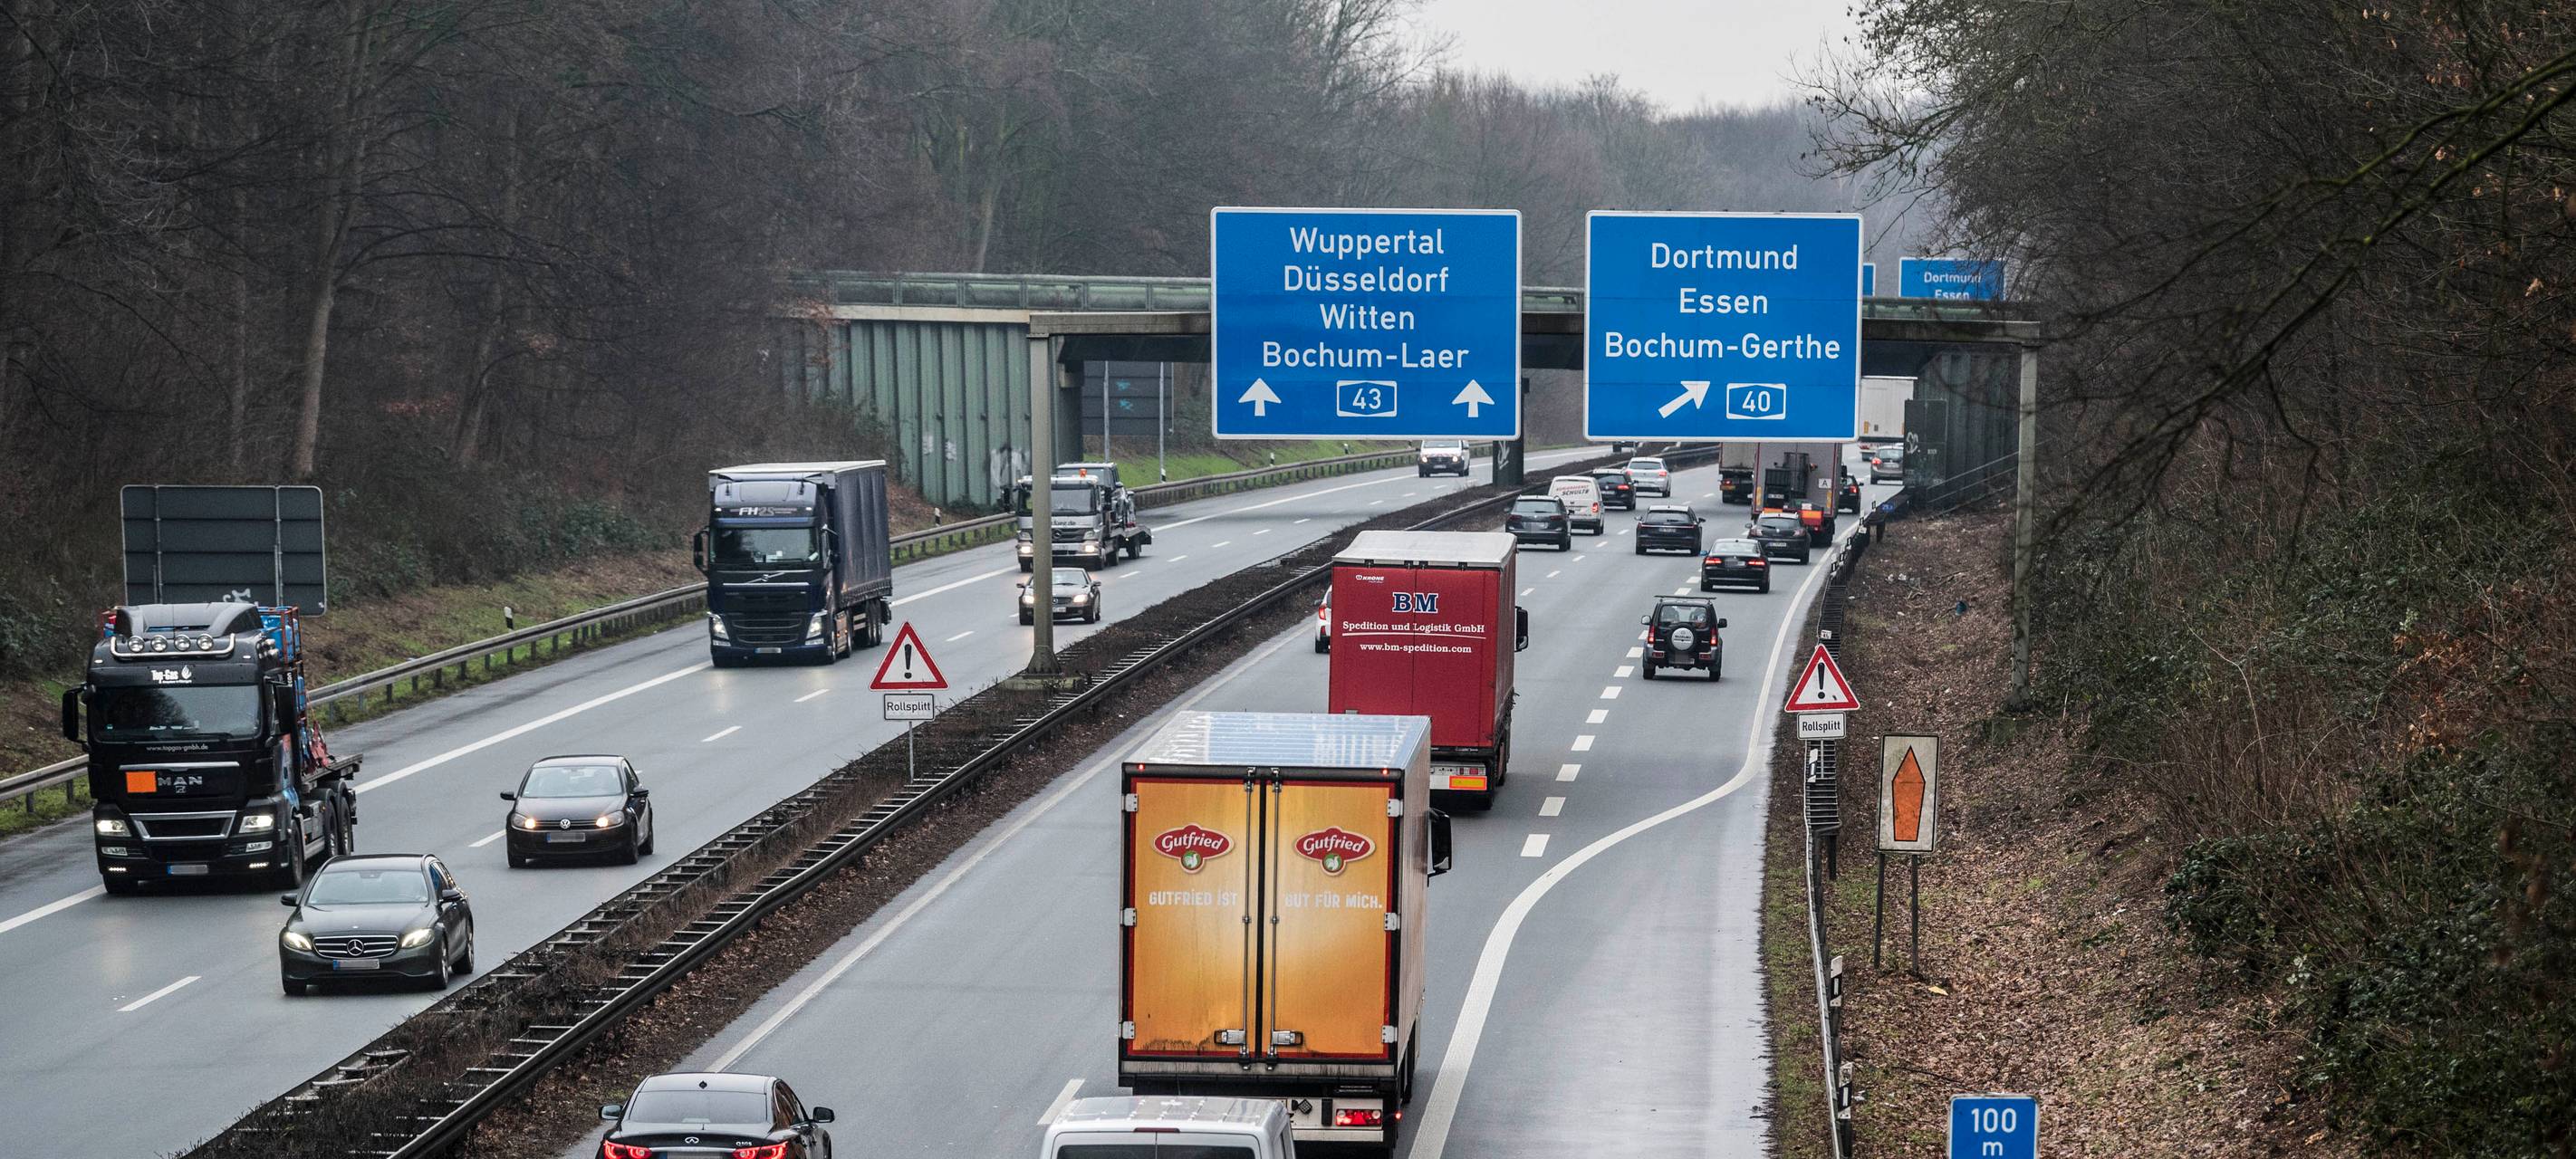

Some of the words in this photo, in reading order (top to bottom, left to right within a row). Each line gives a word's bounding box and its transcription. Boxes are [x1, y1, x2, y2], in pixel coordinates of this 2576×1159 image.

[1291, 228, 1444, 256] Wuppertal
[1651, 243, 1798, 270] Dortmund
[1284, 265, 1449, 292] Düsseldorf
[1924, 272, 1982, 283] Dortmund
[1680, 288, 1768, 314] Essen
[1935, 289, 1970, 300] Essen
[1320, 303, 1415, 330] Witten
[1263, 341, 1469, 369] Bochum-Laer
[1605, 331, 1841, 359] Bochum-Gerthe
[1352, 388, 1381, 409] 43
[1742, 390, 1771, 412] 40
[1392, 591, 1439, 613] BM
[1342, 621, 1389, 631] Spedition
[1391, 622, 1410, 631] und
[1413, 622, 1451, 634] Logistik
[1455, 624, 1485, 633] GmbH
[1360, 643, 1472, 654] www.bm-spedition.com
[887, 701, 930, 713] Rollsplitt
[1802, 721, 1841, 733] Rollsplitt
[158, 776, 203, 786] MAN
[1161, 831, 1224, 852] Gutfried
[1302, 835, 1365, 855] Gutfried
[1285, 892, 1310, 908] GUT
[1315, 890, 1340, 908] FÜR
[1971, 1107, 2017, 1133] 100
[1983, 1141, 2004, 1156] m
